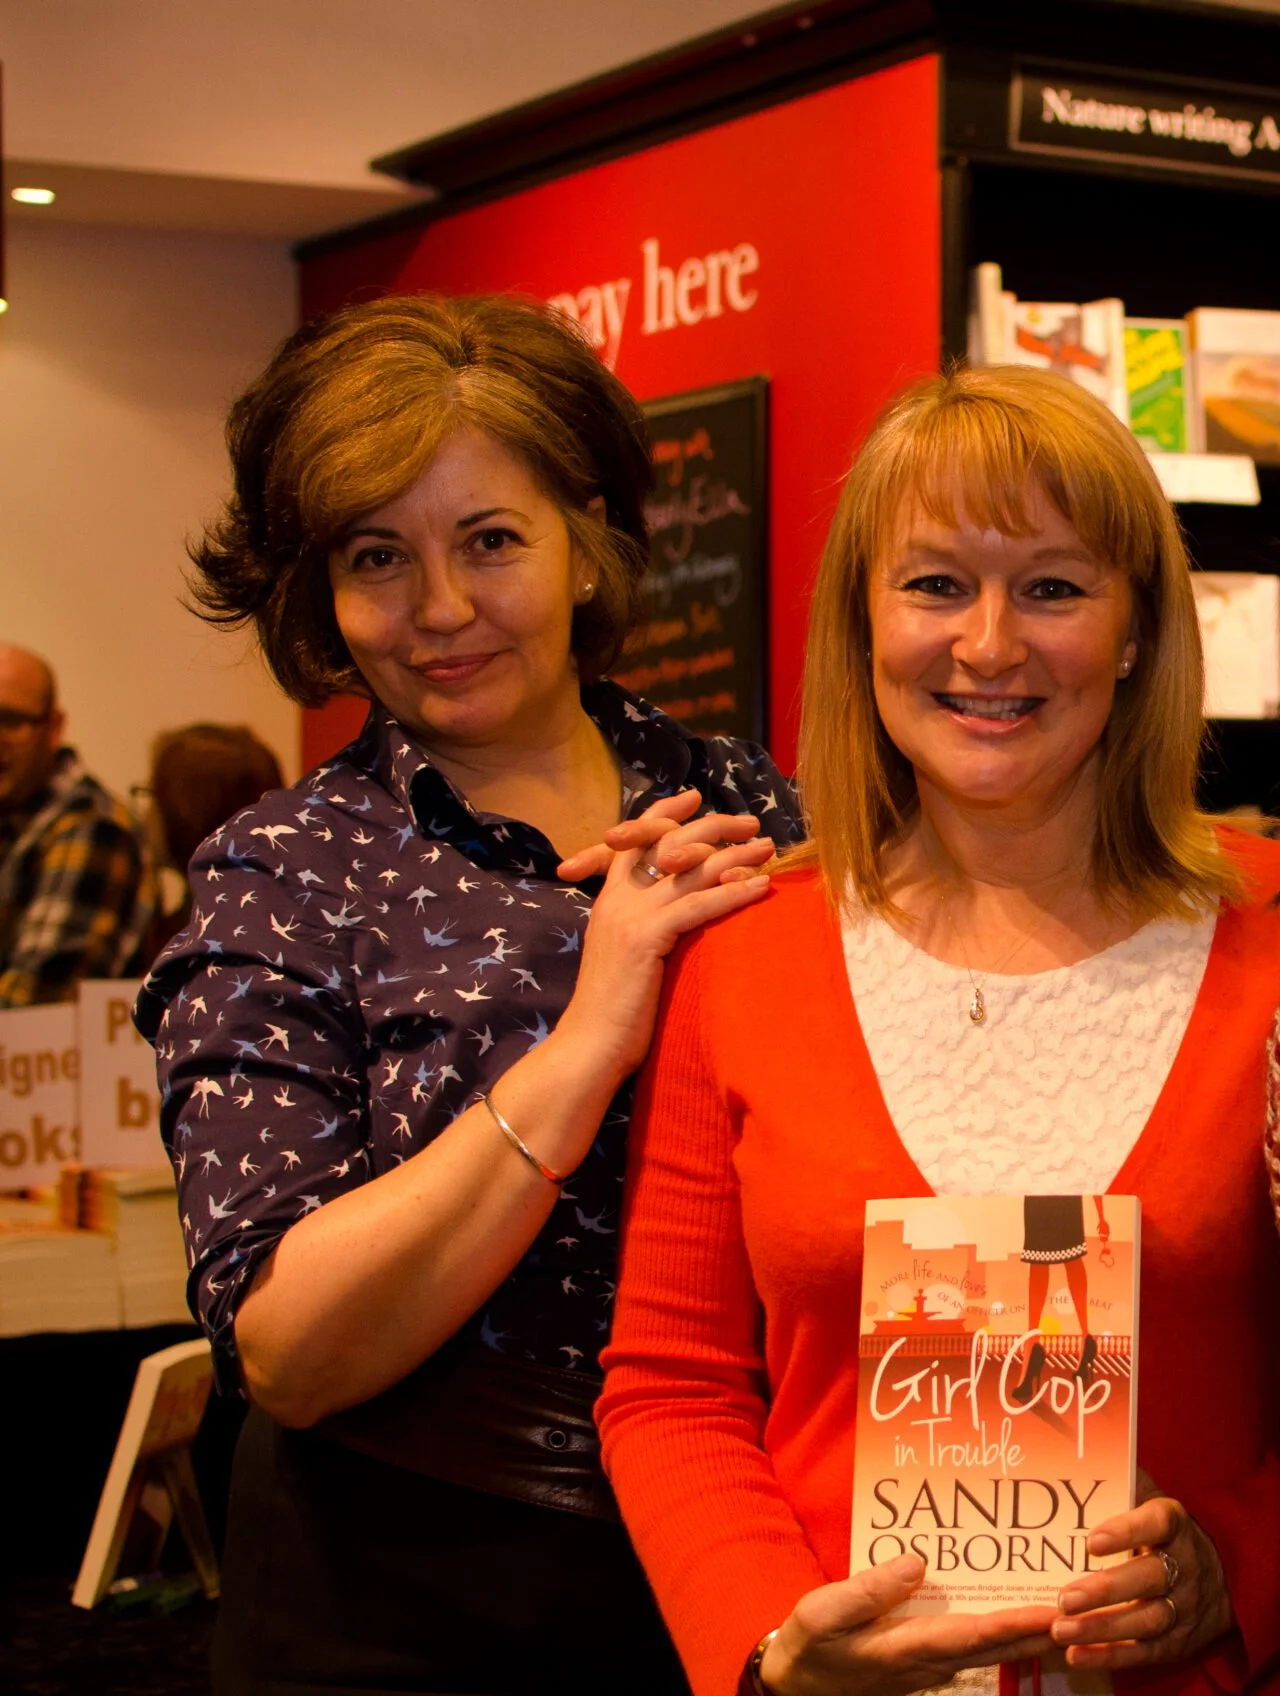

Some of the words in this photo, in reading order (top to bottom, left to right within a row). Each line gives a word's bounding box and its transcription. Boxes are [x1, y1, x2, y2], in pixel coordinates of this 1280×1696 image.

[1042, 86, 1147, 135] Nature
[1148, 103, 1253, 157] writing
[641, 237, 760, 336] here
[880, 1271, 910, 1293] MORE
[912, 1258, 935, 1281] life
[935, 1271, 959, 1287] AND
[937, 1291, 949, 1303] OF
[951, 1300, 965, 1313] AN
[966, 1305, 1008, 1317] OFFICER
[1009, 1303, 1026, 1314] ON
[1049, 1295, 1069, 1306] THE
[1089, 1297, 1113, 1312] BEAT
[870, 1328, 989, 1431] Girl
[999, 1328, 1112, 1460] Cop
[893, 1434, 919, 1467] in
[911, 1416, 1025, 1477] Trouble
[870, 1477, 1107, 1530] SANDY
[968, 1593, 990, 1603] police
[978, 1583, 1004, 1593] Bridget
